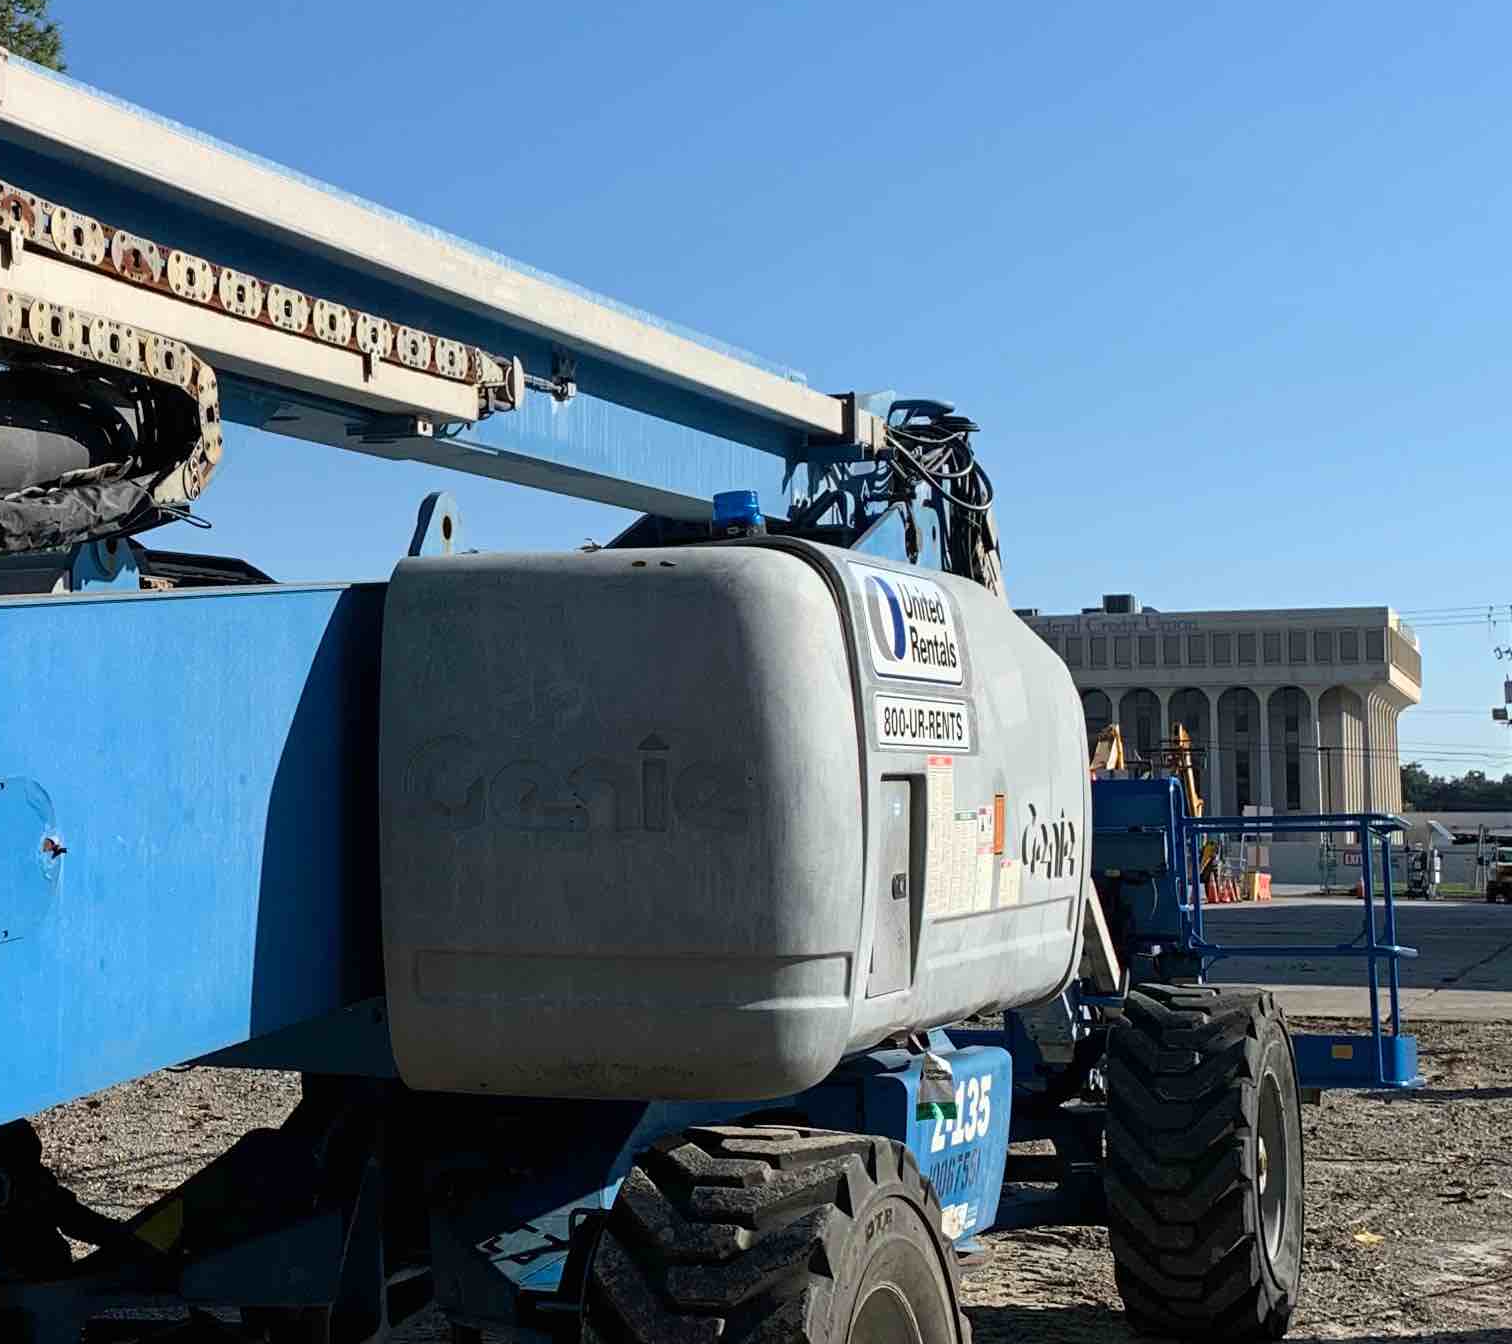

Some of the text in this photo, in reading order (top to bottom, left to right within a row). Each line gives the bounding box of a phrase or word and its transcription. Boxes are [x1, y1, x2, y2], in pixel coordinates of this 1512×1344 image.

[897, 583, 946, 625] United
[909, 626, 957, 668] Rentals
[884, 707, 963, 740] 800-UR-RENTS
